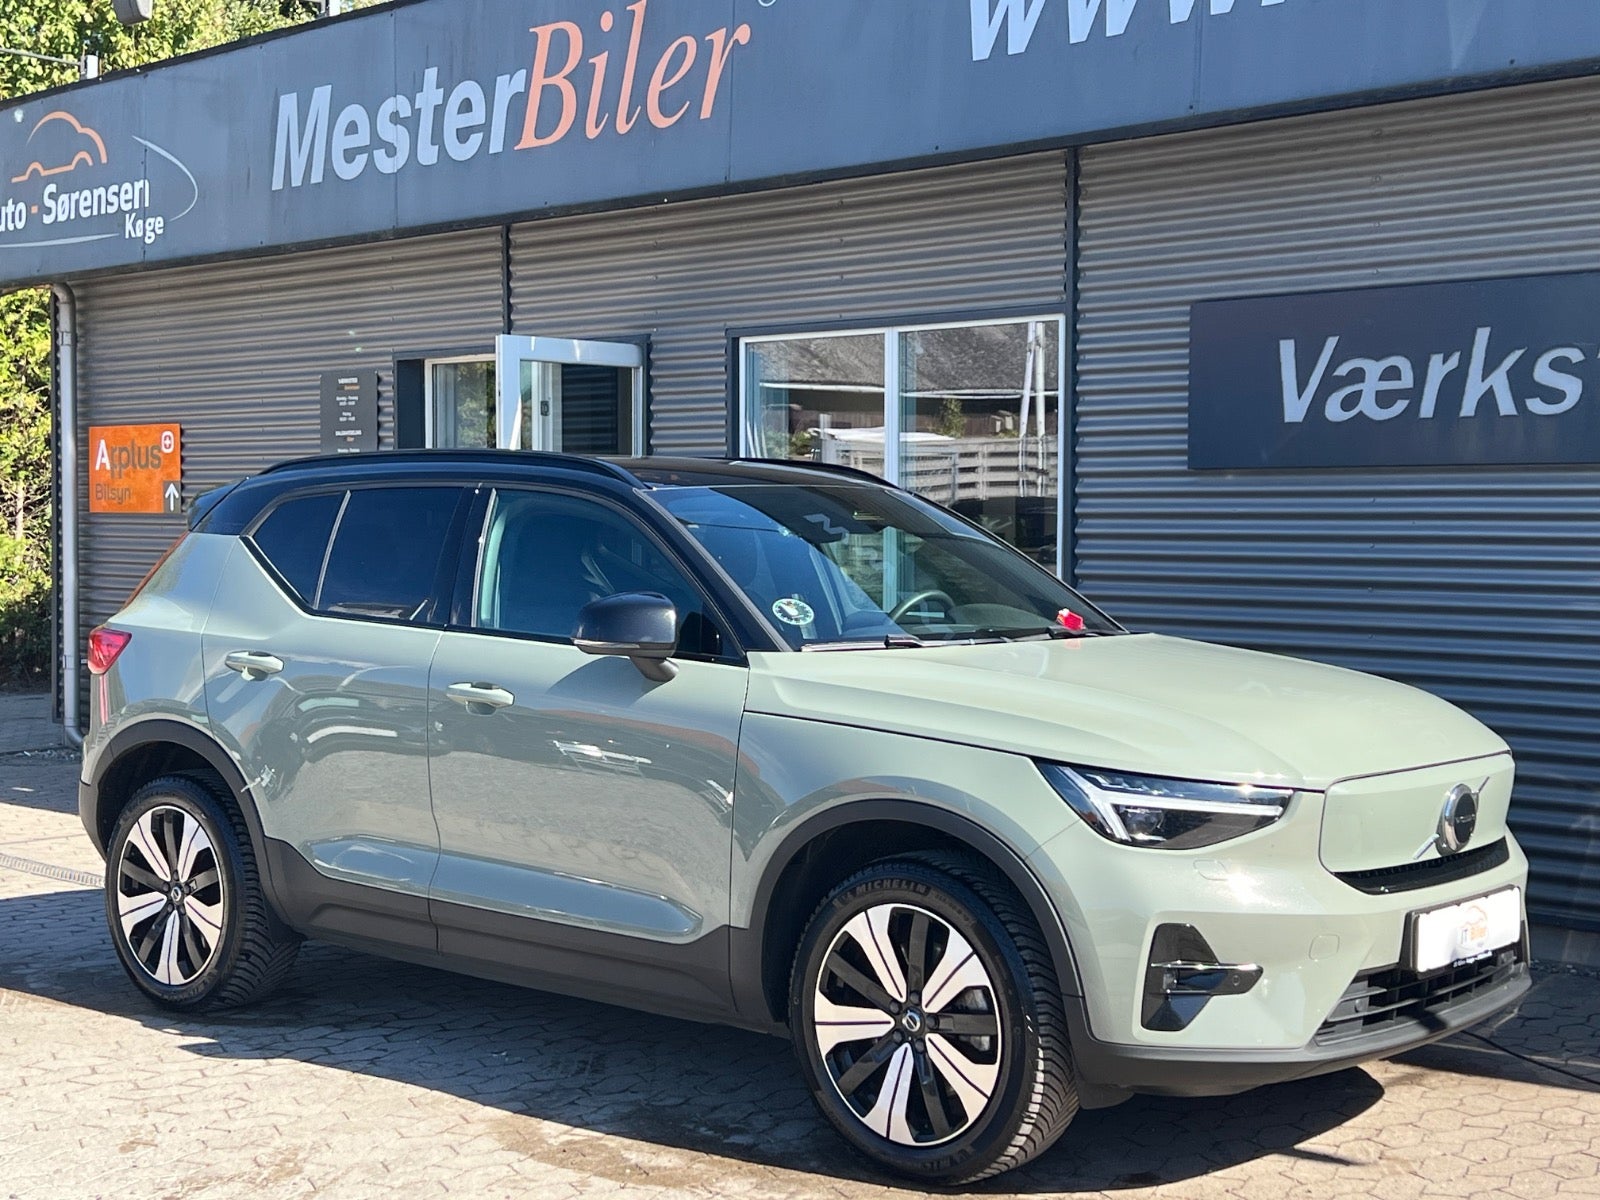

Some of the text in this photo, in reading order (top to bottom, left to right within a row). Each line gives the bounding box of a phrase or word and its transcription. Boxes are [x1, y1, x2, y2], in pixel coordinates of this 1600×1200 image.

[42, 179, 150, 225] Sørensen
[124, 212, 165, 245] Køge
[1278, 326, 1600, 423] Værks
[95, 483, 131, 505] Bilsyn
[855, 879, 927, 896] MICHELIN
